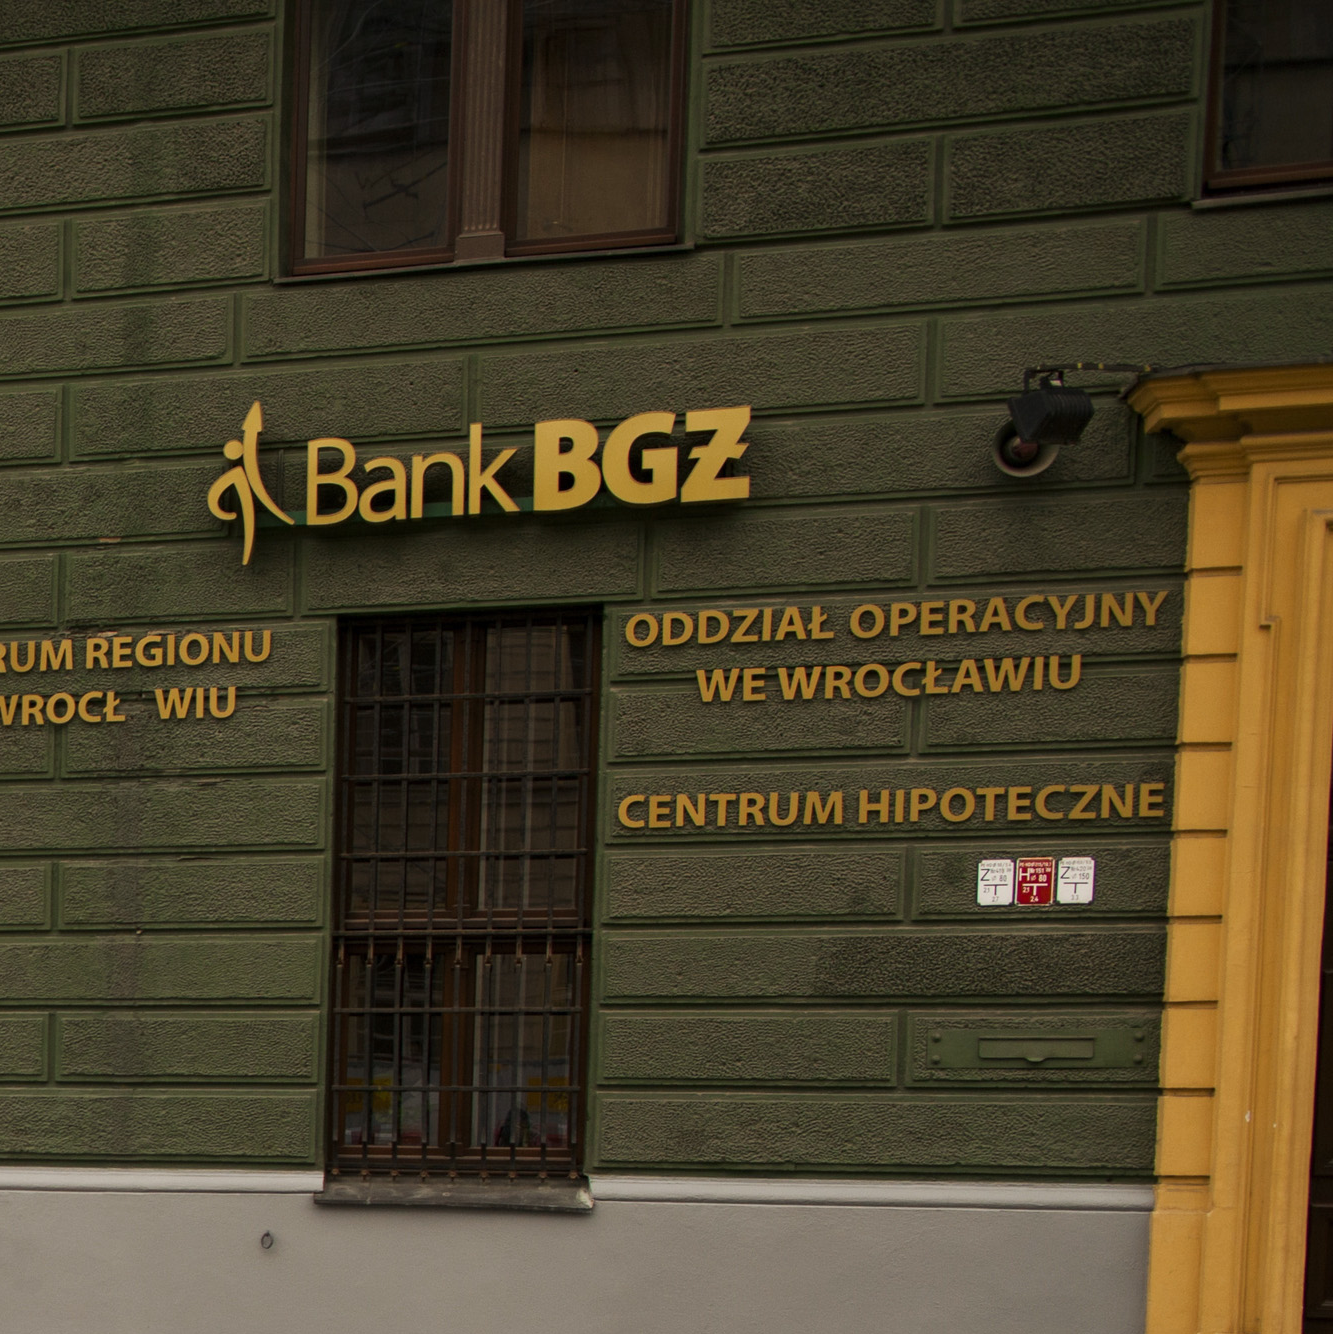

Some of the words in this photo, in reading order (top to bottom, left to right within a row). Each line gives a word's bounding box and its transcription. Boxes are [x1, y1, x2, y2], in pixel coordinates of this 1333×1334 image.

[307, 422, 520, 526] Bank
[625, 605, 834, 647] ODDZIAŁ
[849, 590, 1170, 640] OPERACYJNY
[85, 629, 272, 670] REGIONU
[696, 667, 767, 702] WE
[777, 654, 1082, 699] WROCŁAWIU
[618, 791, 844, 829] CENTRUM
[858, 782, 1166, 824] HIPOTECZNE
[980, 868, 990, 881] Z
[1019, 867, 1030, 881] H
[1038, 874, 1048, 882] 80
[1060, 866, 1070, 879] Z
[1078, 872, 1090, 880] 150
